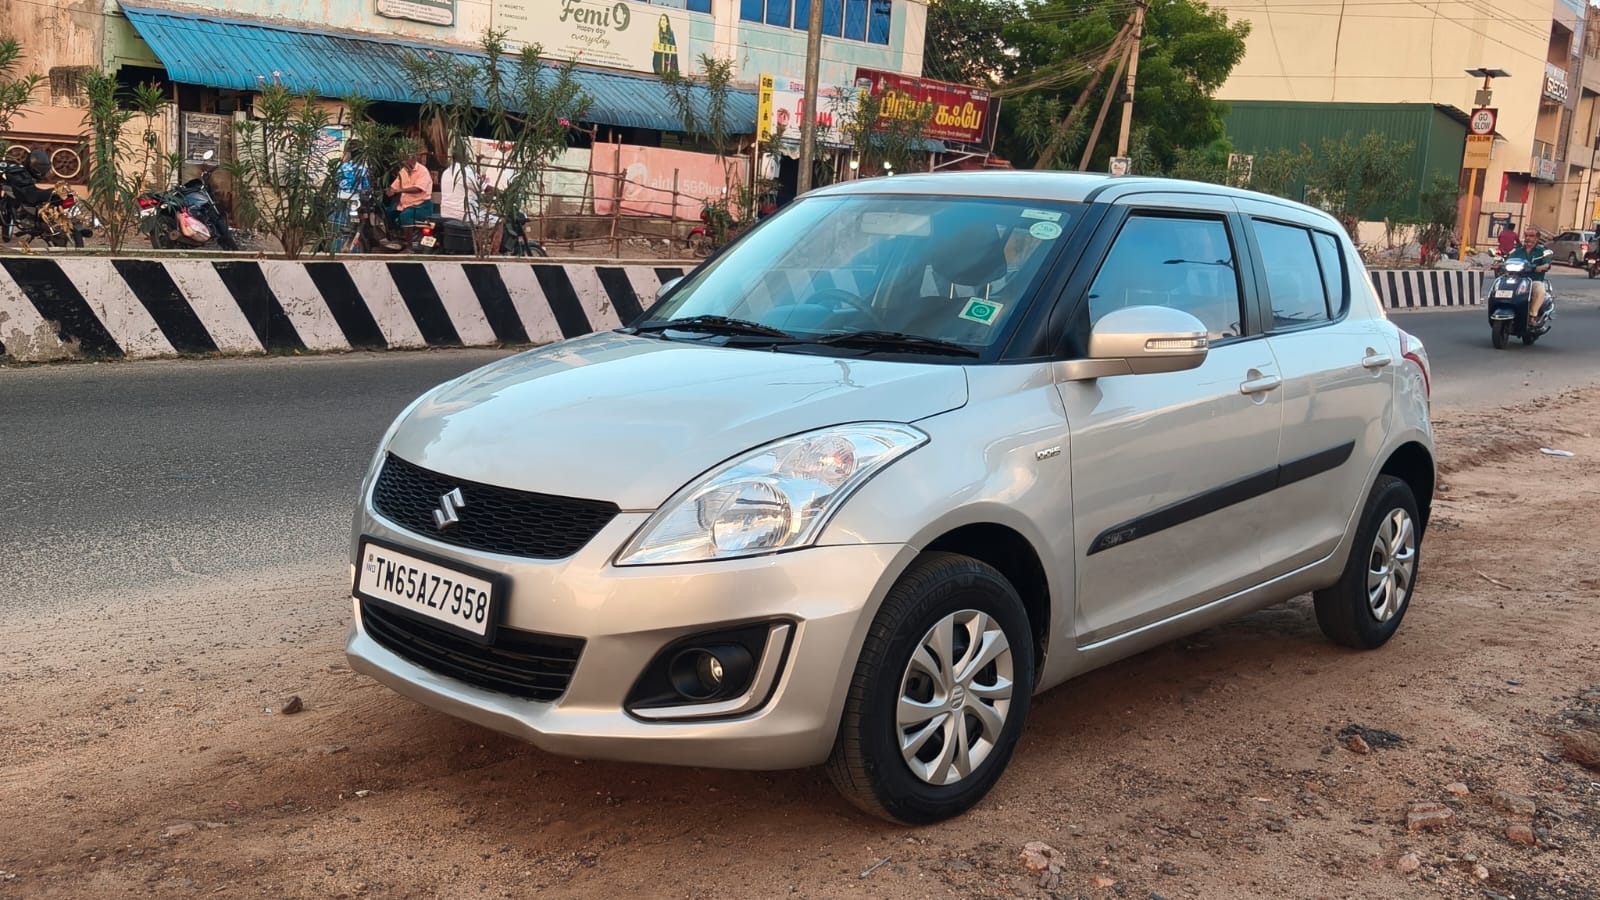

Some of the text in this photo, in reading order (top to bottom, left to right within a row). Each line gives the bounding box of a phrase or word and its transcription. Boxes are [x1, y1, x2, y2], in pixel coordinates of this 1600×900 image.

[1478, 113, 1488, 121] GO
[1474, 121, 1491, 130] SLOW
[376, 557, 488, 623] TN65AZ7958
